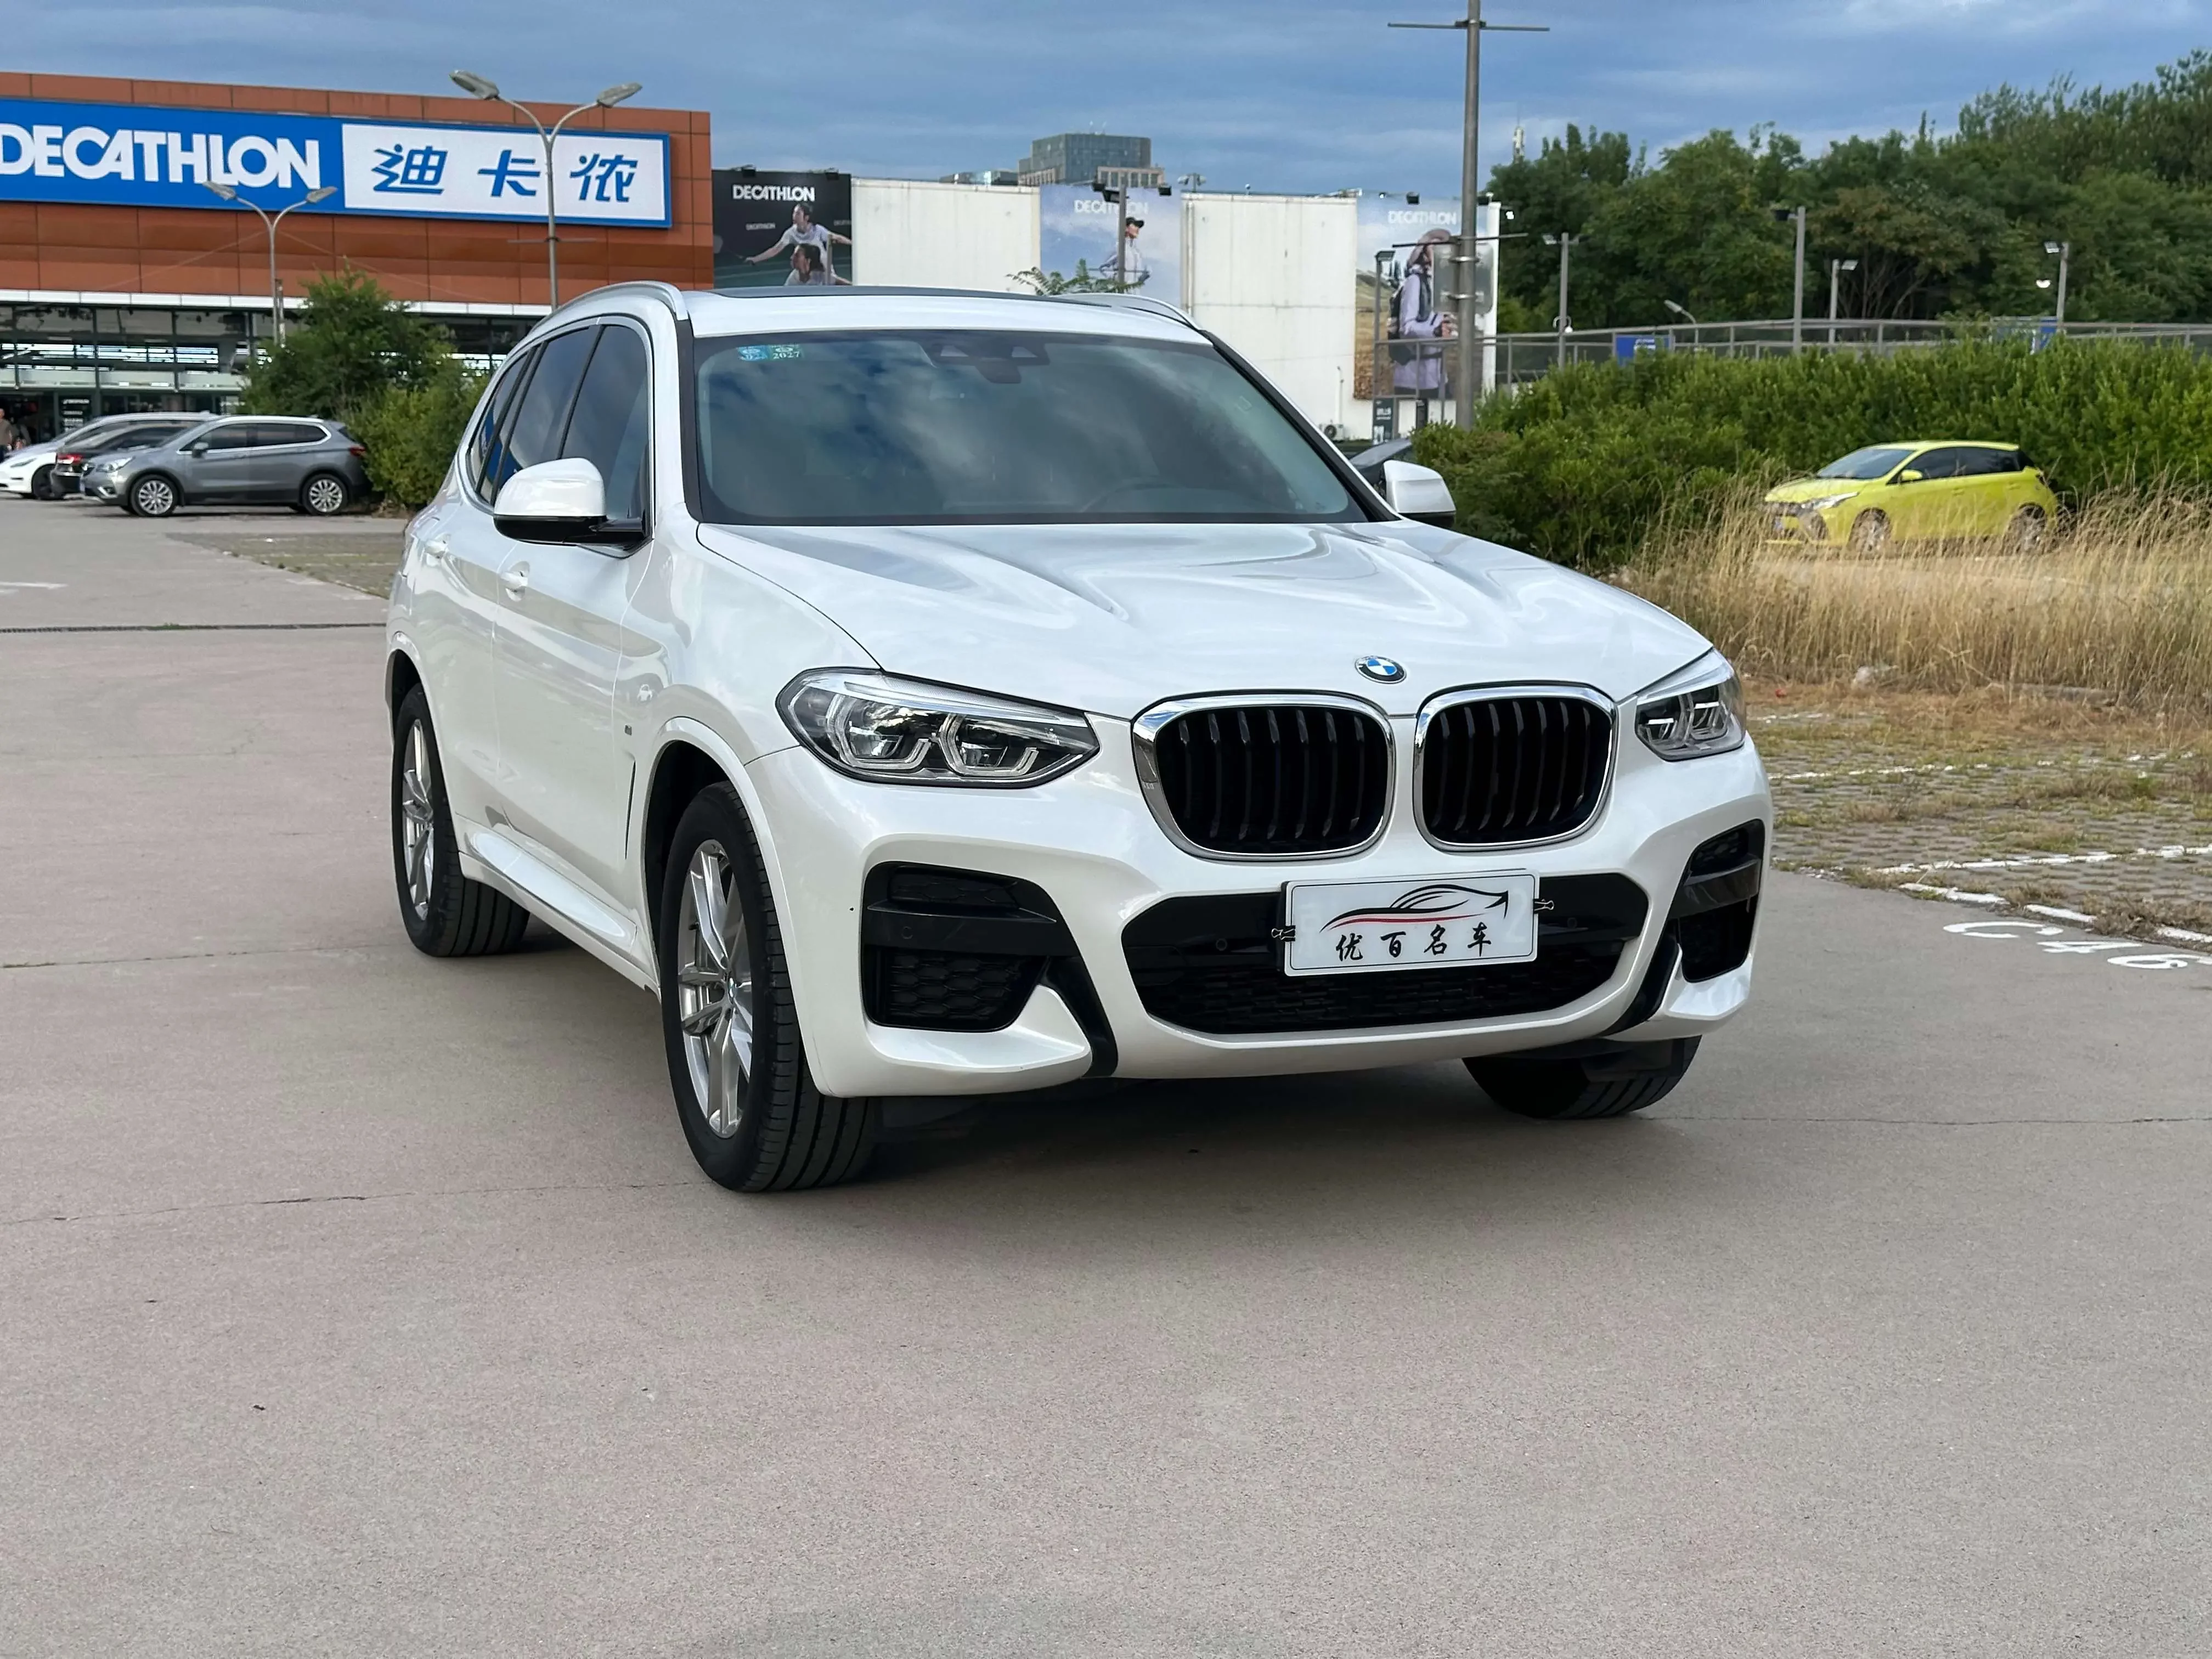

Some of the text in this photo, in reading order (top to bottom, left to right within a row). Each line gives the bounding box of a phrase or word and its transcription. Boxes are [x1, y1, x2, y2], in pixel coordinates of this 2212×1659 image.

[0, 123, 321, 189] DECATHLON
[371, 144, 638, 202] 迪卡侬
[732, 184, 815, 202] DECATHLON
[1074, 199, 1149, 215] DECATON
[1387, 211, 1457, 225] DECATHLON
[1335, 922, 1492, 962] 优百名车
